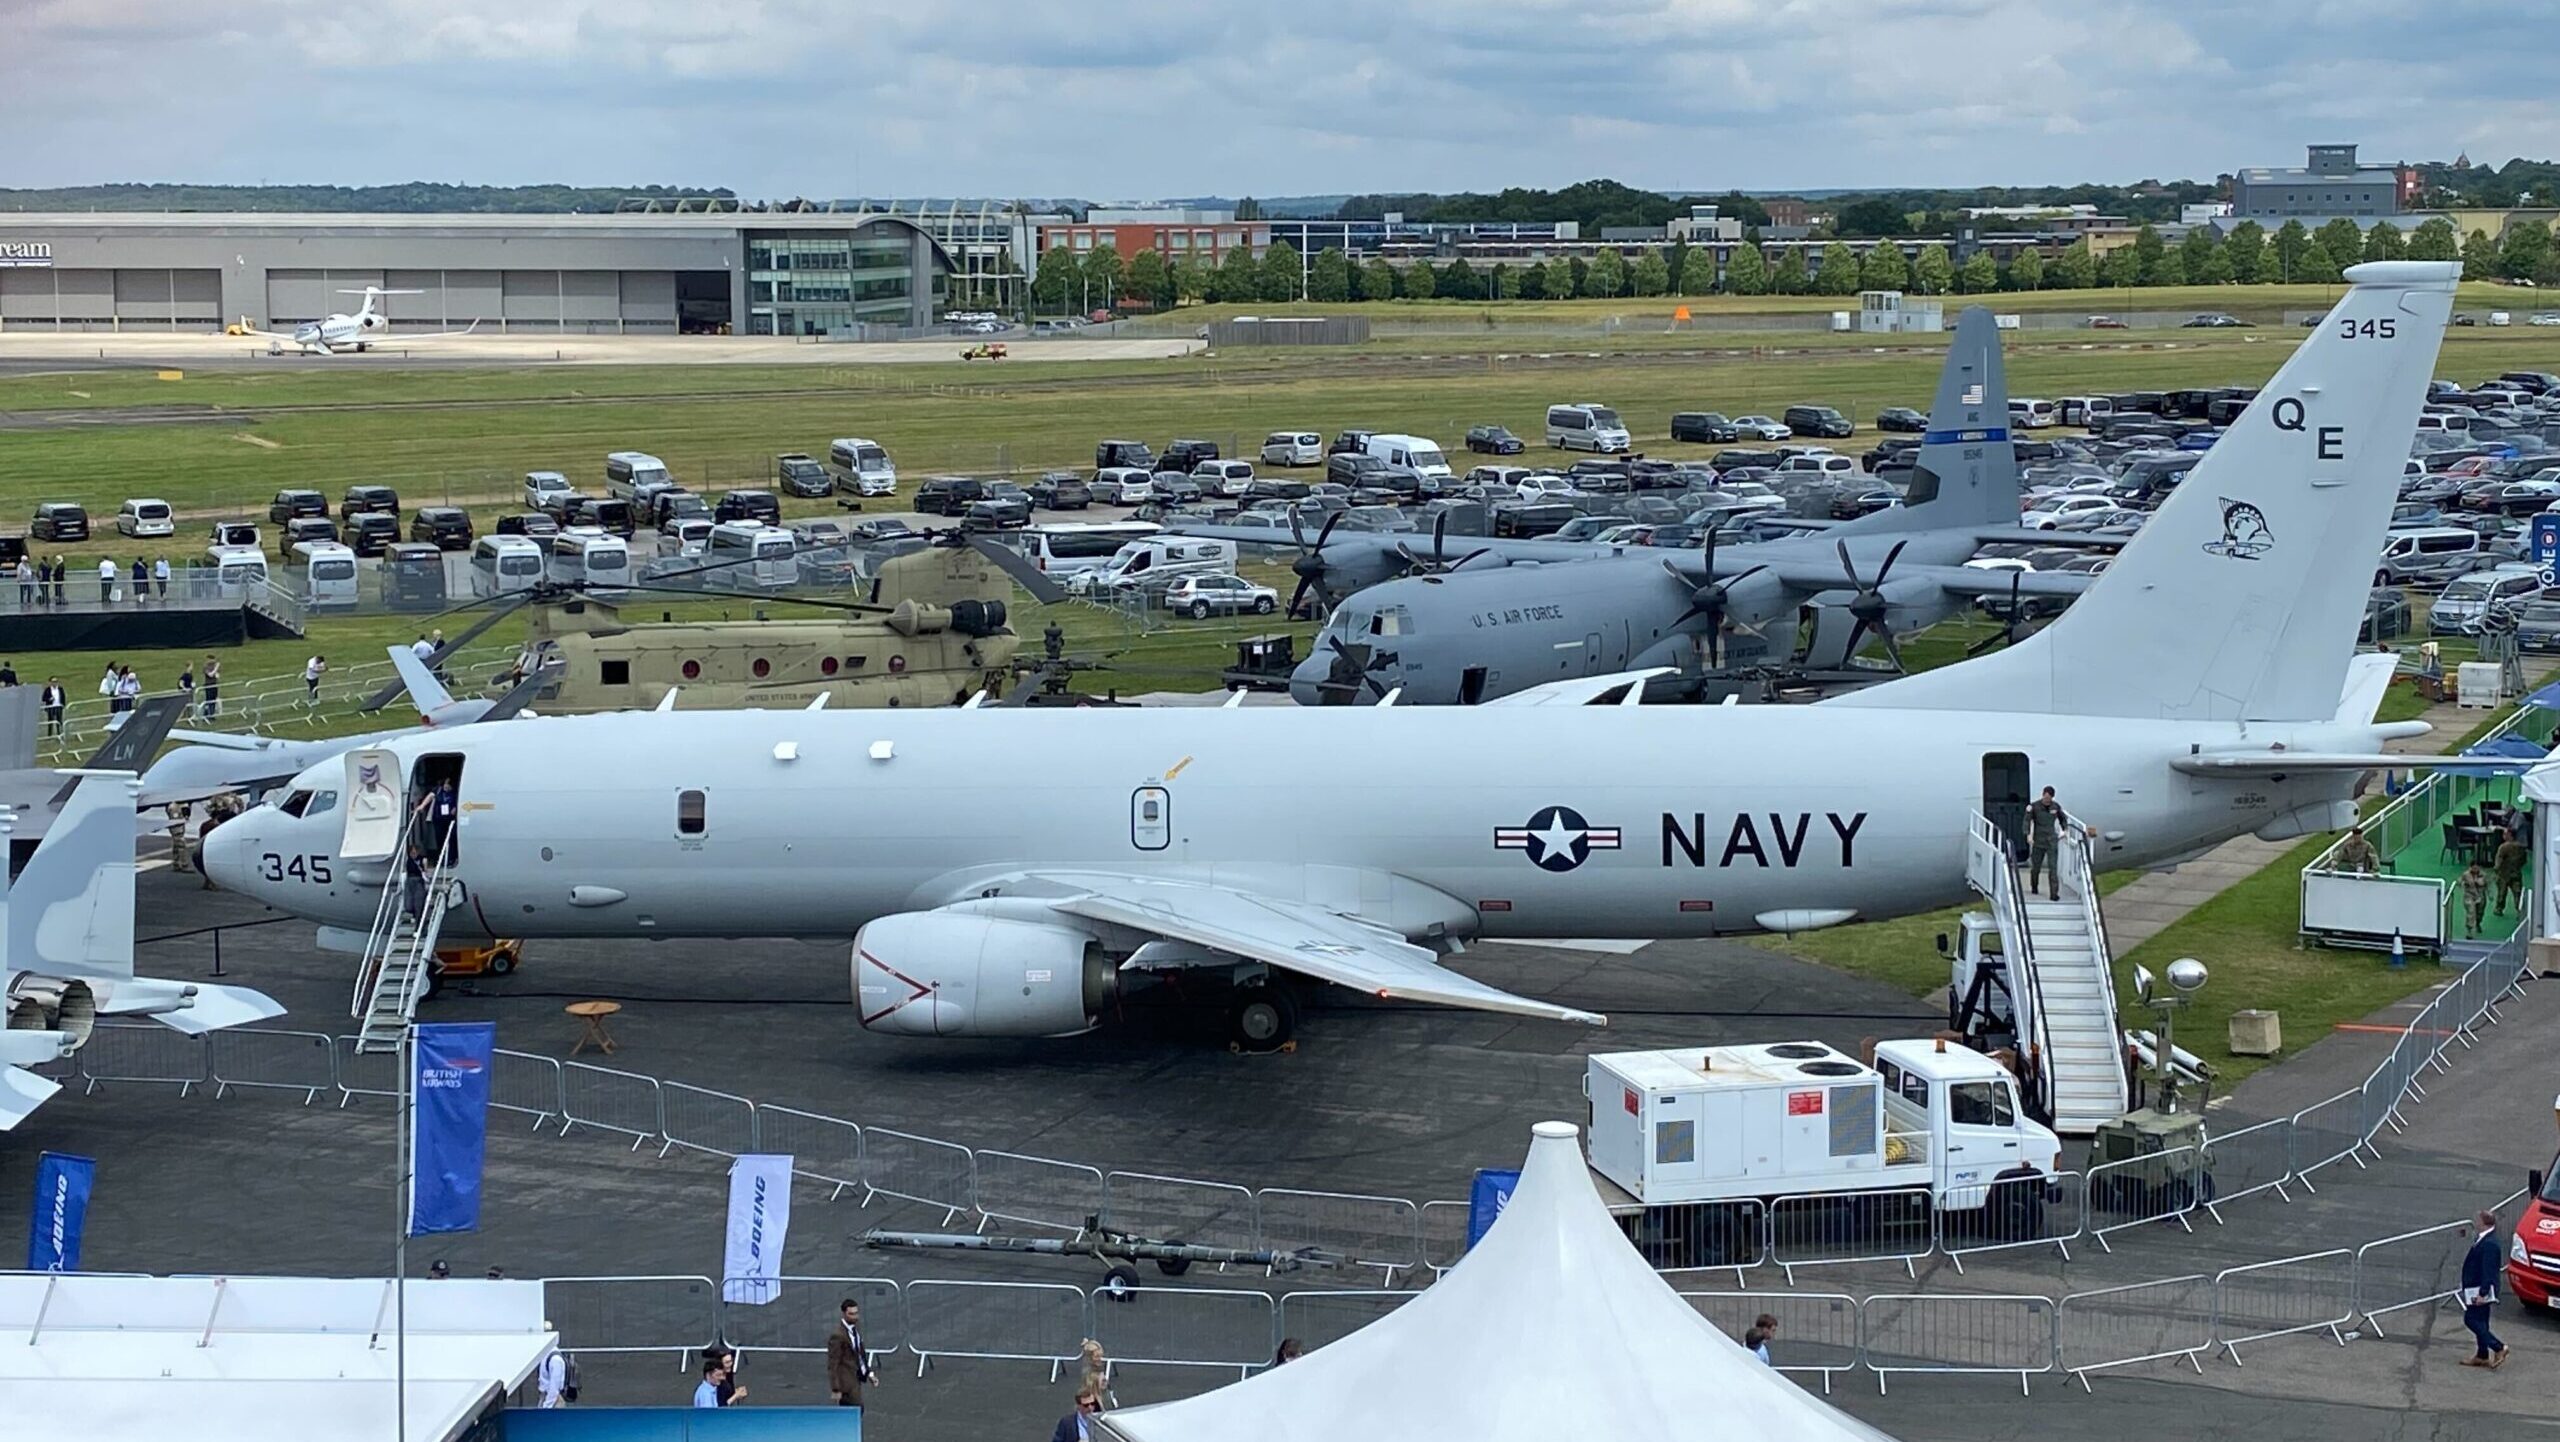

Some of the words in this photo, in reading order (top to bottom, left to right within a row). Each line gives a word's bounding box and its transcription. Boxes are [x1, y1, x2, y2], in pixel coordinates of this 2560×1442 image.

[2340, 319, 2396, 339] 345
[2272, 397, 2306, 432] Q
[2318, 427, 2344, 459] E
[1503, 609, 1523, 625] AIR
[1524, 604, 1564, 622] FORCE
[113, 743, 135, 761] LN
[1662, 812, 1868, 868] NAVY
[263, 853, 332, 884] 345
[422, 1068, 463, 1079] BRITISH
[53, 1174, 68, 1256] BOEING
[751, 1175, 766, 1259] BOEING
